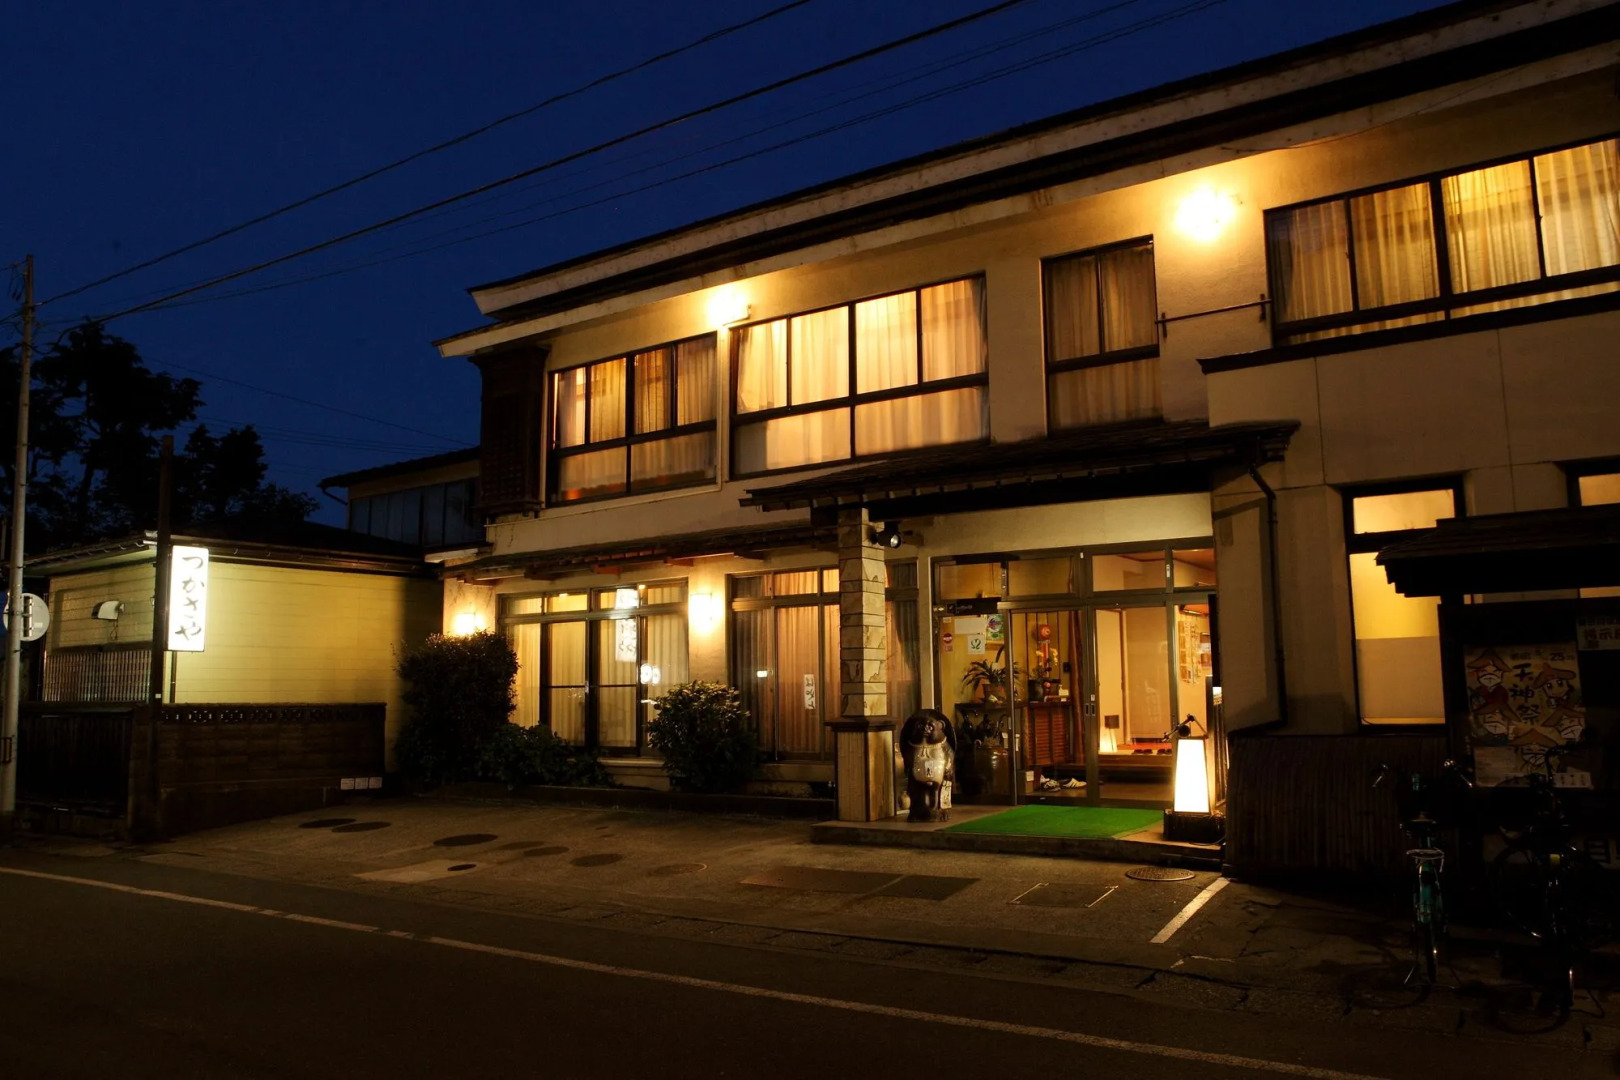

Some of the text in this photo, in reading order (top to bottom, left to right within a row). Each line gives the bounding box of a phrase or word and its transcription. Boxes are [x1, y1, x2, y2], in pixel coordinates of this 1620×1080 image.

[175, 557, 205, 640] つかさや
[1509, 662, 1540, 725] 天神祭
